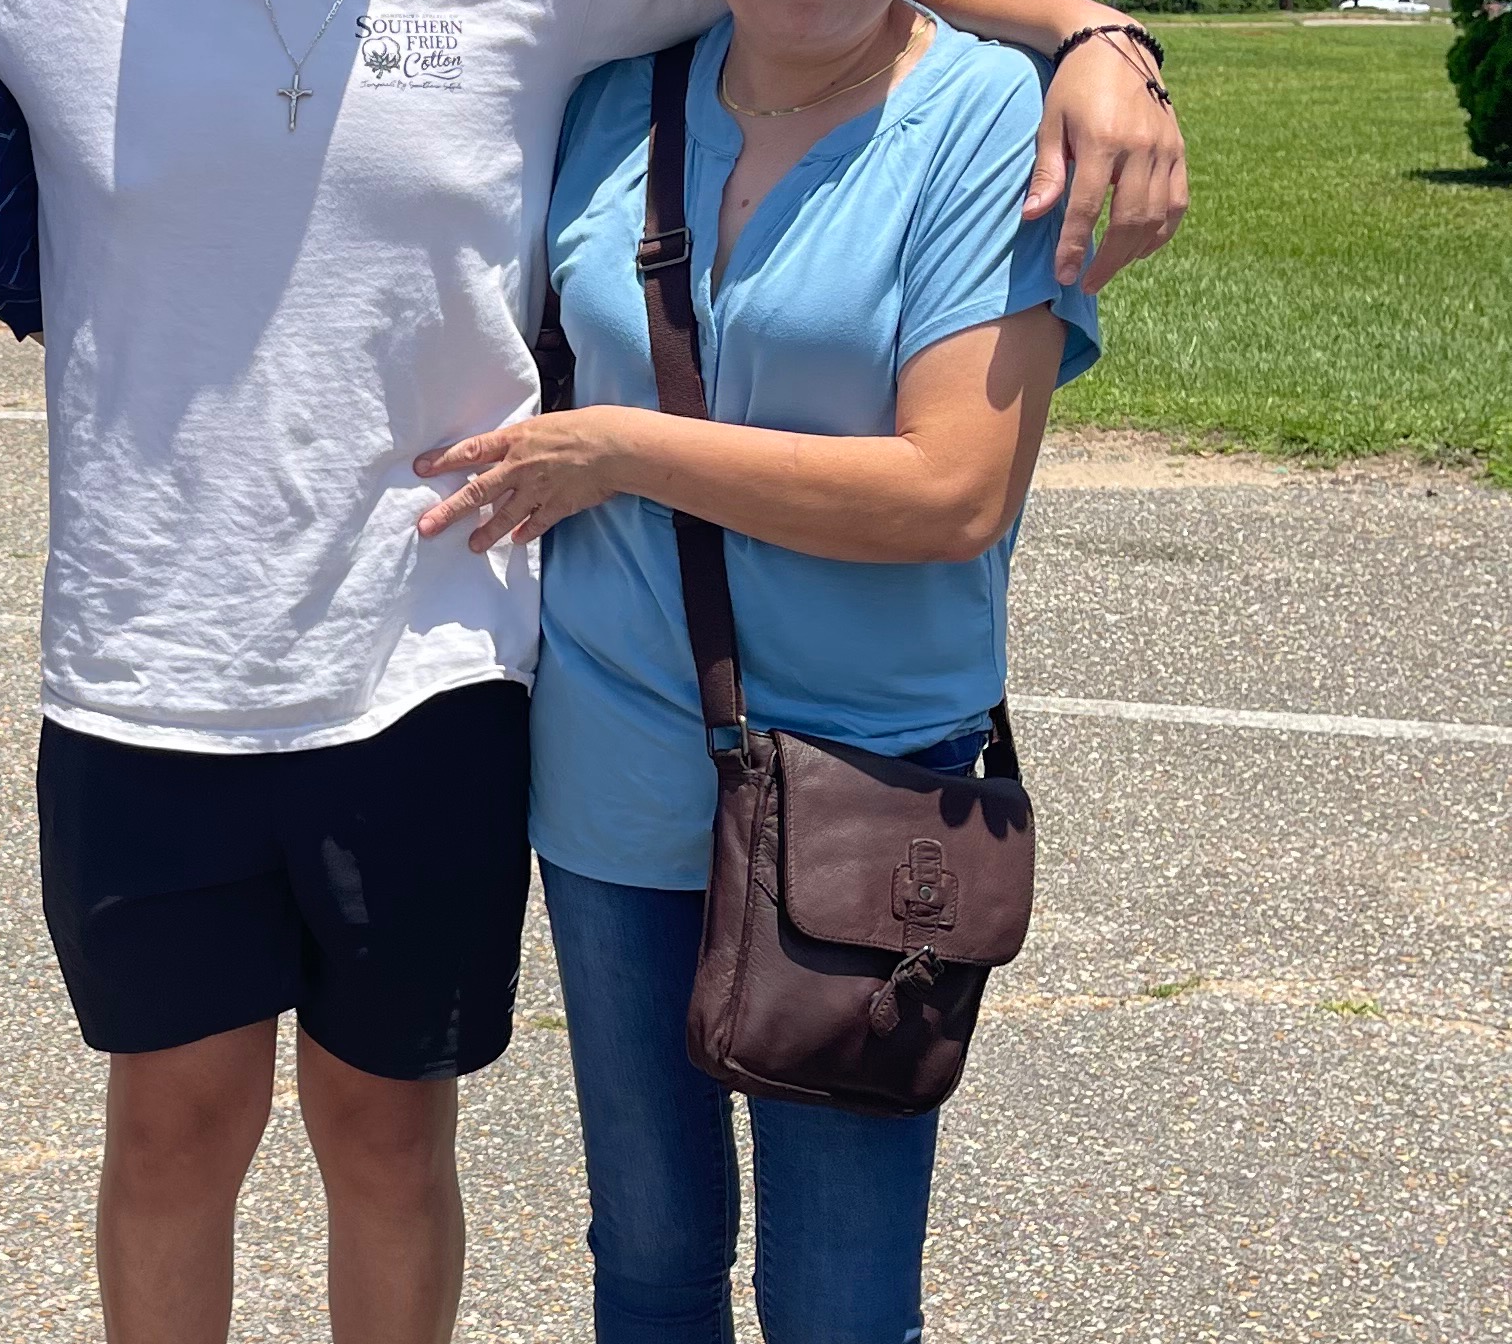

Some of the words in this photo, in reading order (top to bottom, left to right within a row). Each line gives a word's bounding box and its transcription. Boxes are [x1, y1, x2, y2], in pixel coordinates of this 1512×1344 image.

[355, 16, 463, 38] SOUTHERN
[406, 35, 458, 51] FRIED
[403, 49, 463, 78] Cotton
